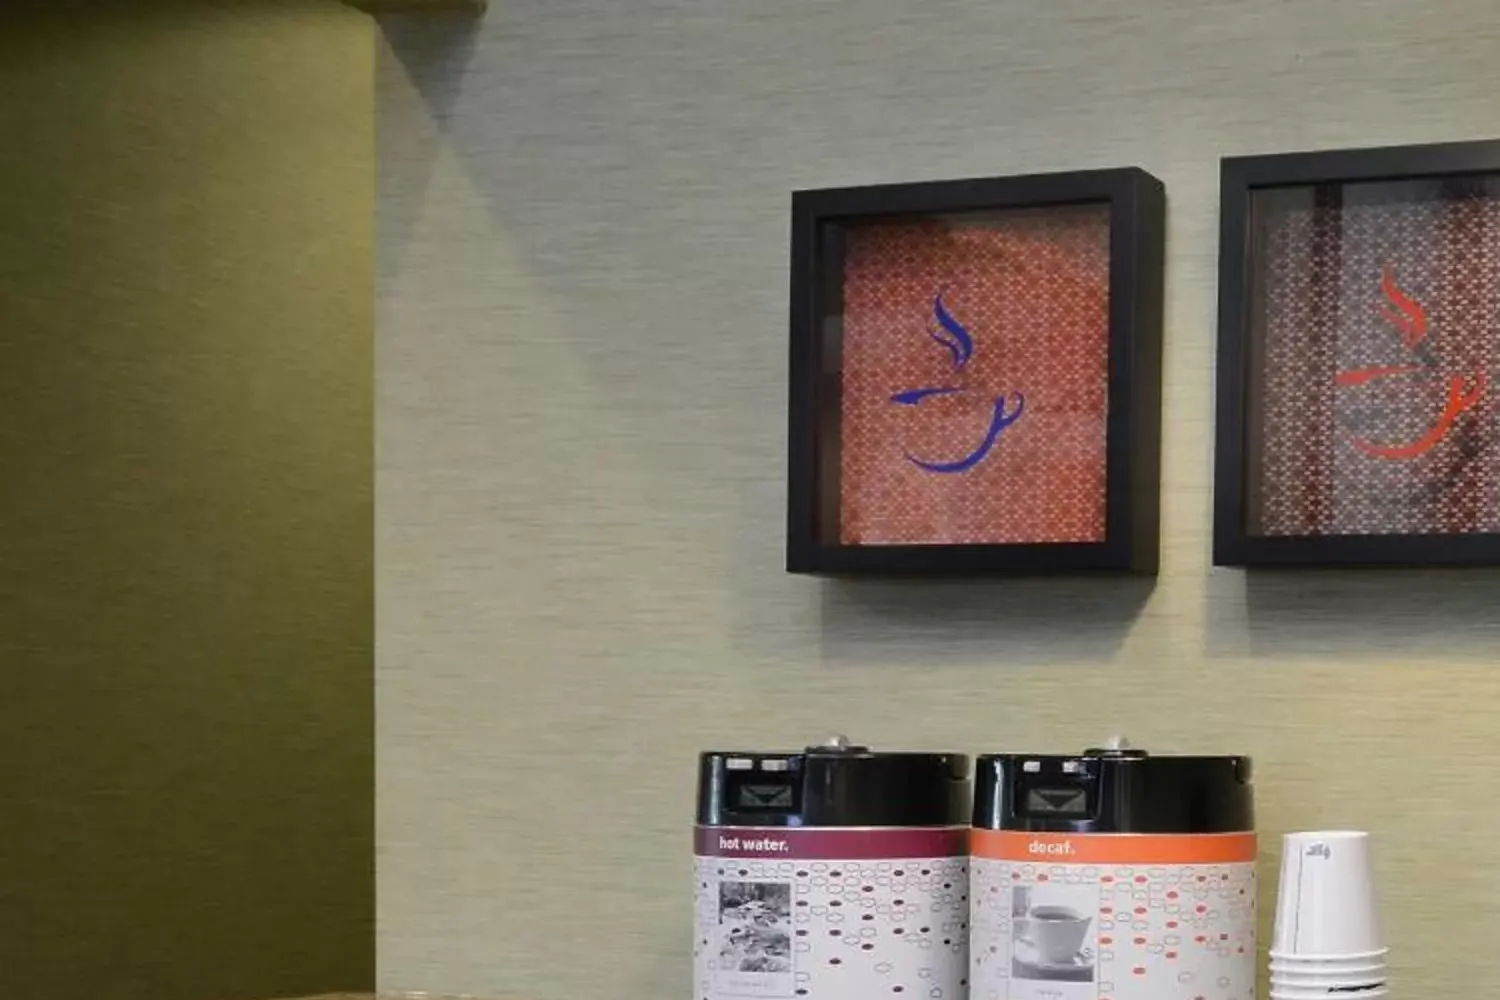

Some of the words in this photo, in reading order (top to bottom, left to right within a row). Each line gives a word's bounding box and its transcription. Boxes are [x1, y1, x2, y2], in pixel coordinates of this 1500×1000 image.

[719, 835, 740, 850] hot
[743, 839, 789, 852] water.
[1028, 839, 1076, 855] decaf.
